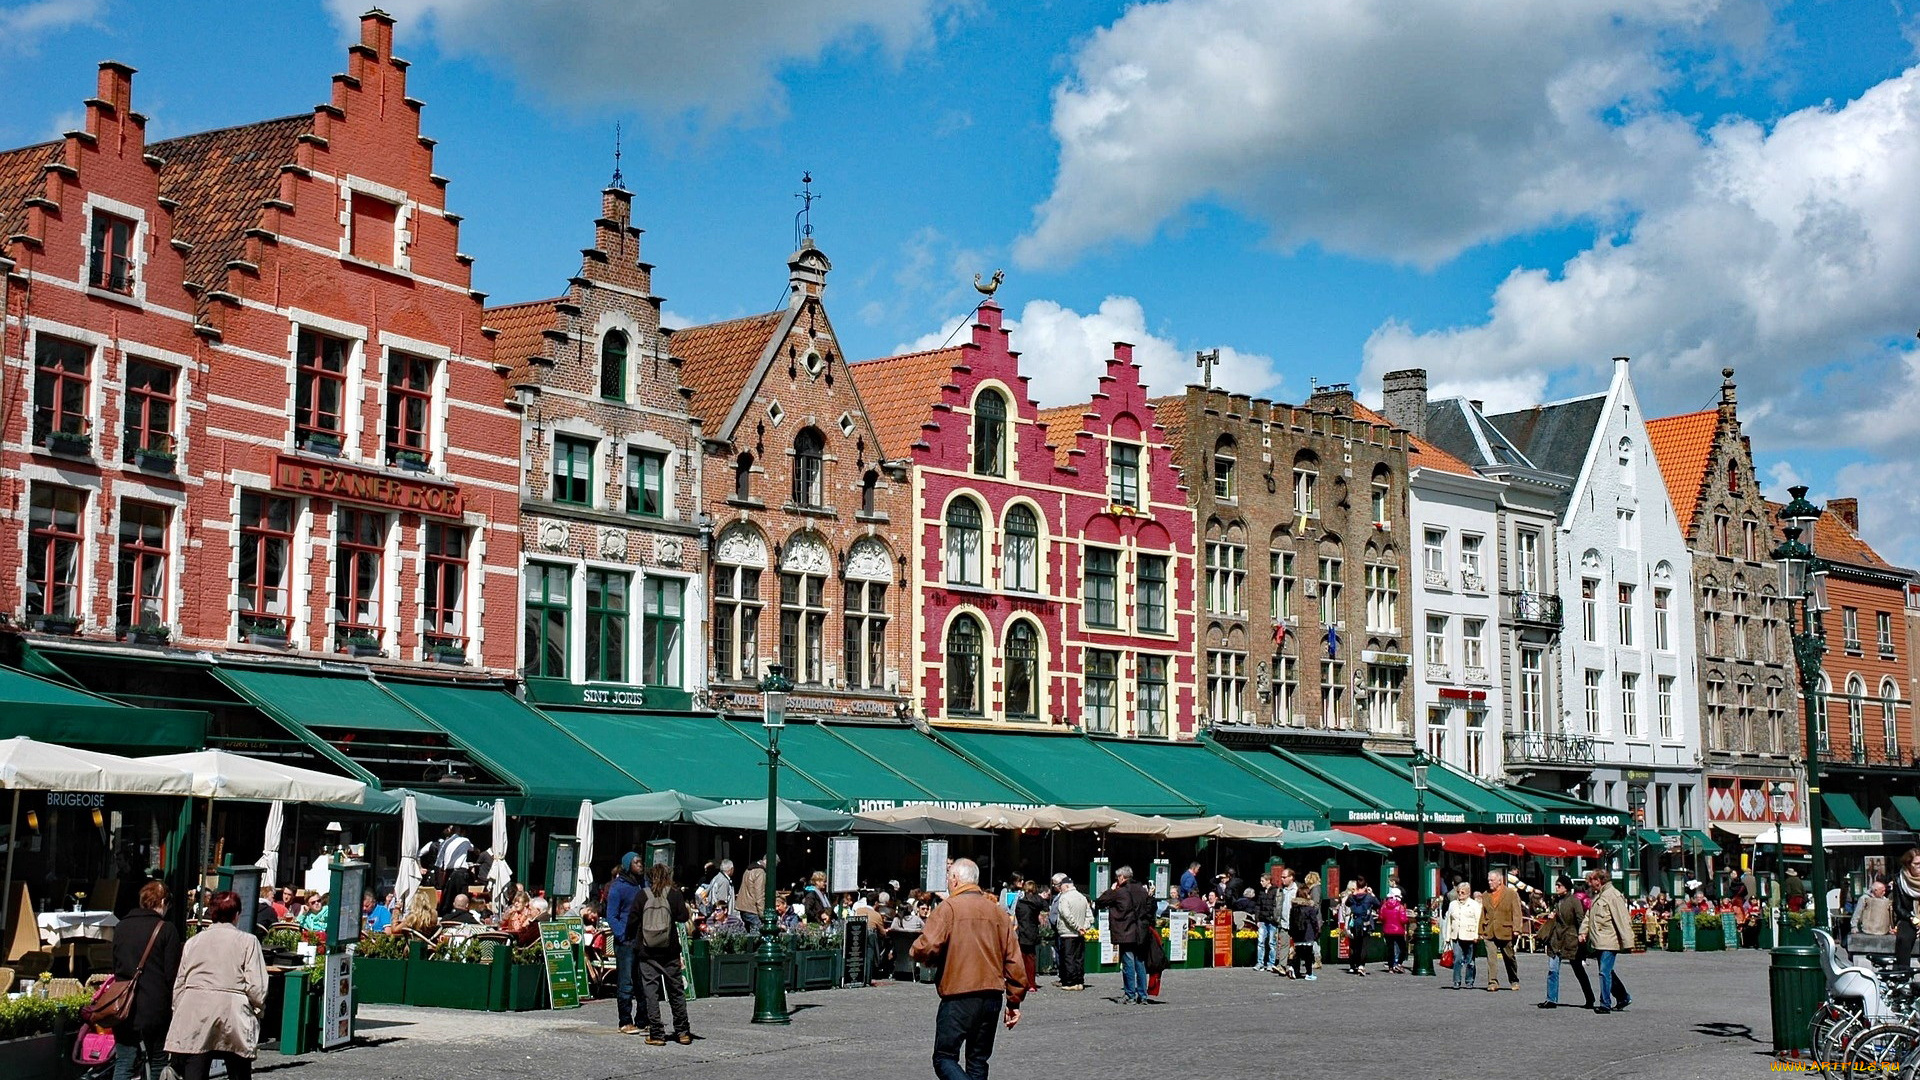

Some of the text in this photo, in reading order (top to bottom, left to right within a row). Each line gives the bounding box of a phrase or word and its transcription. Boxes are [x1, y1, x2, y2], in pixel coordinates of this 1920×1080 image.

[283, 466, 461, 513] LE PANIER D'OR
[583, 690, 642, 705] SINT JORIS
[785, 697, 835, 710] ESTAURANT
[850, 702, 889, 714] CENTRAL
[47, 793, 104, 807] BRUGEOISE
[1349, 810, 1380, 820] Brasserie
[1385, 812, 1394, 821] La
[1434, 812, 1464, 823] Restaurant
[1496, 814, 1514, 823] PETIT
[1560, 815, 1620, 825] Friterie 1900
[1287, 819, 1315, 832] ARTS
